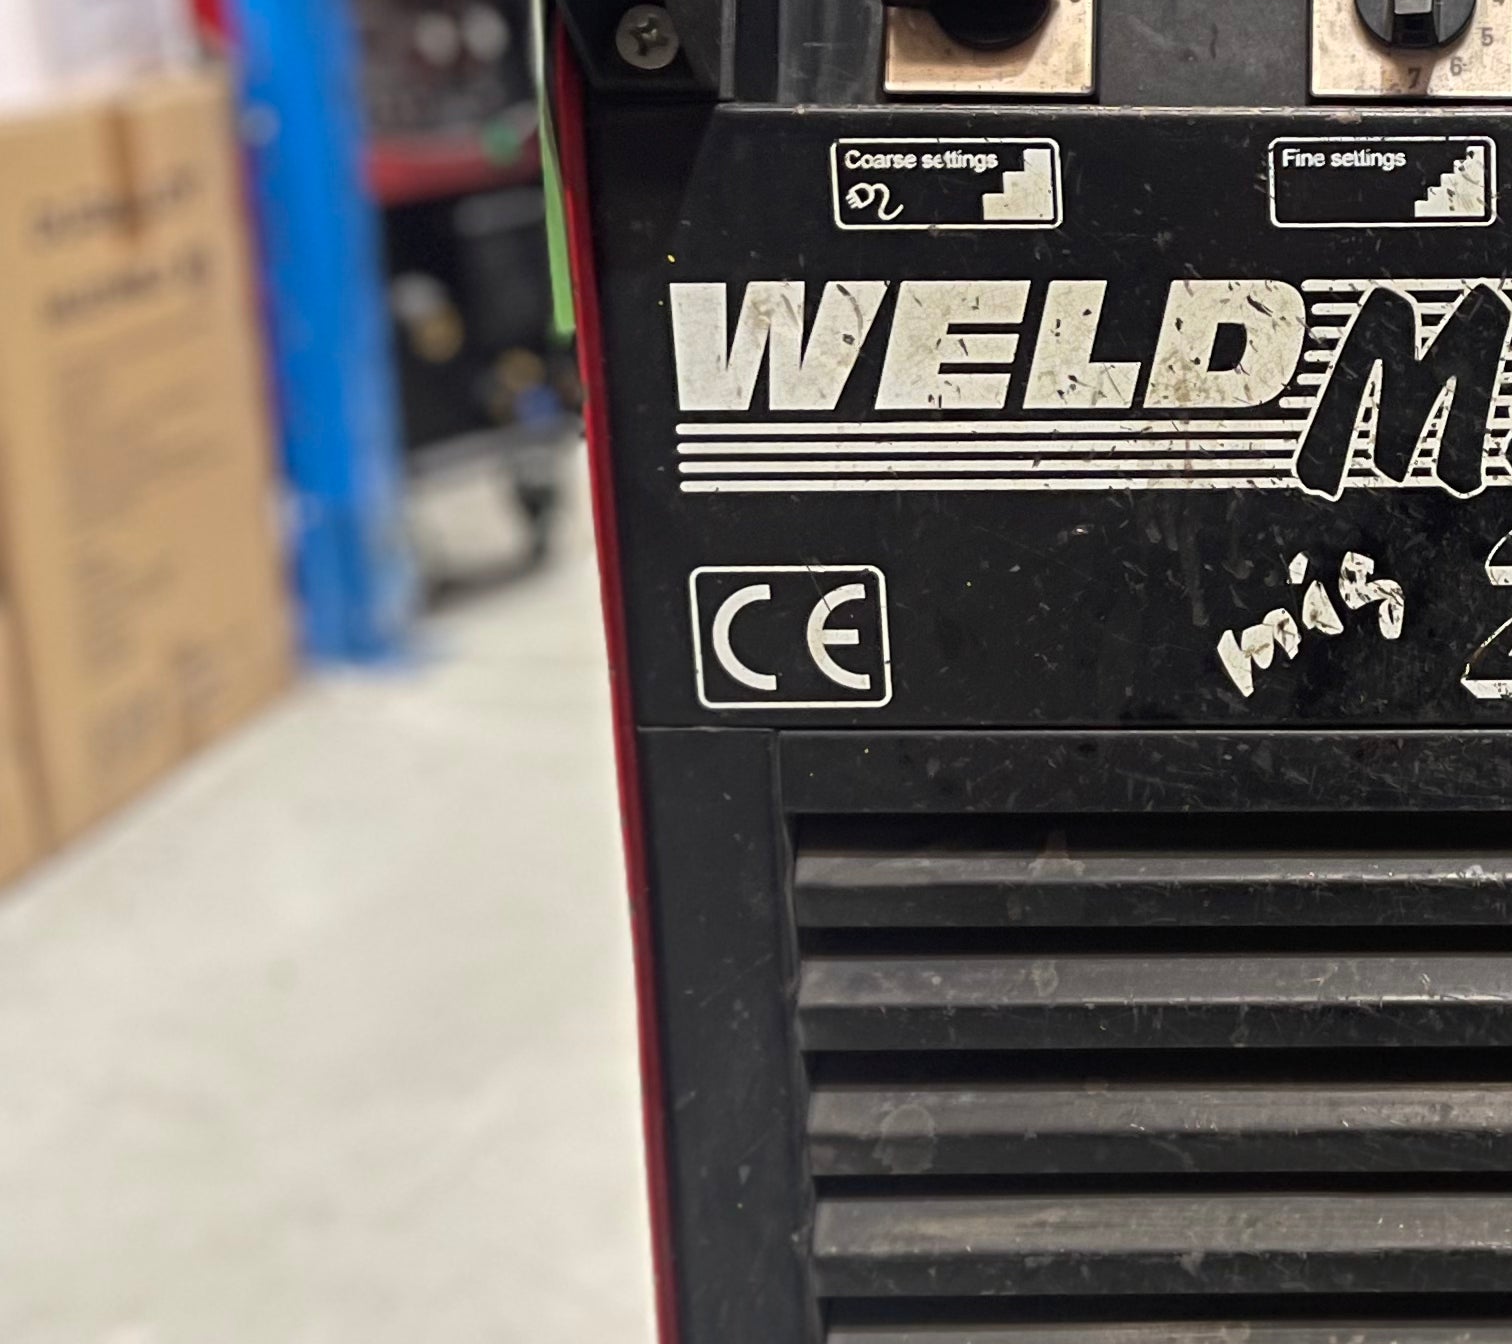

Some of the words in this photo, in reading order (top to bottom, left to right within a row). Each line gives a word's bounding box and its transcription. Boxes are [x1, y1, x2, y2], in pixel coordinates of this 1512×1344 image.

[1481, 28, 1493, 46] 5
[1450, 57, 1463, 76] 6
[1408, 68, 1420, 88] 7
[845, 150, 917, 171] Coarse
[922, 150, 998, 173] settings
[1282, 148, 1325, 169] Fine
[1330, 148, 1406, 172] settings
[711, 584, 871, 693] CE
